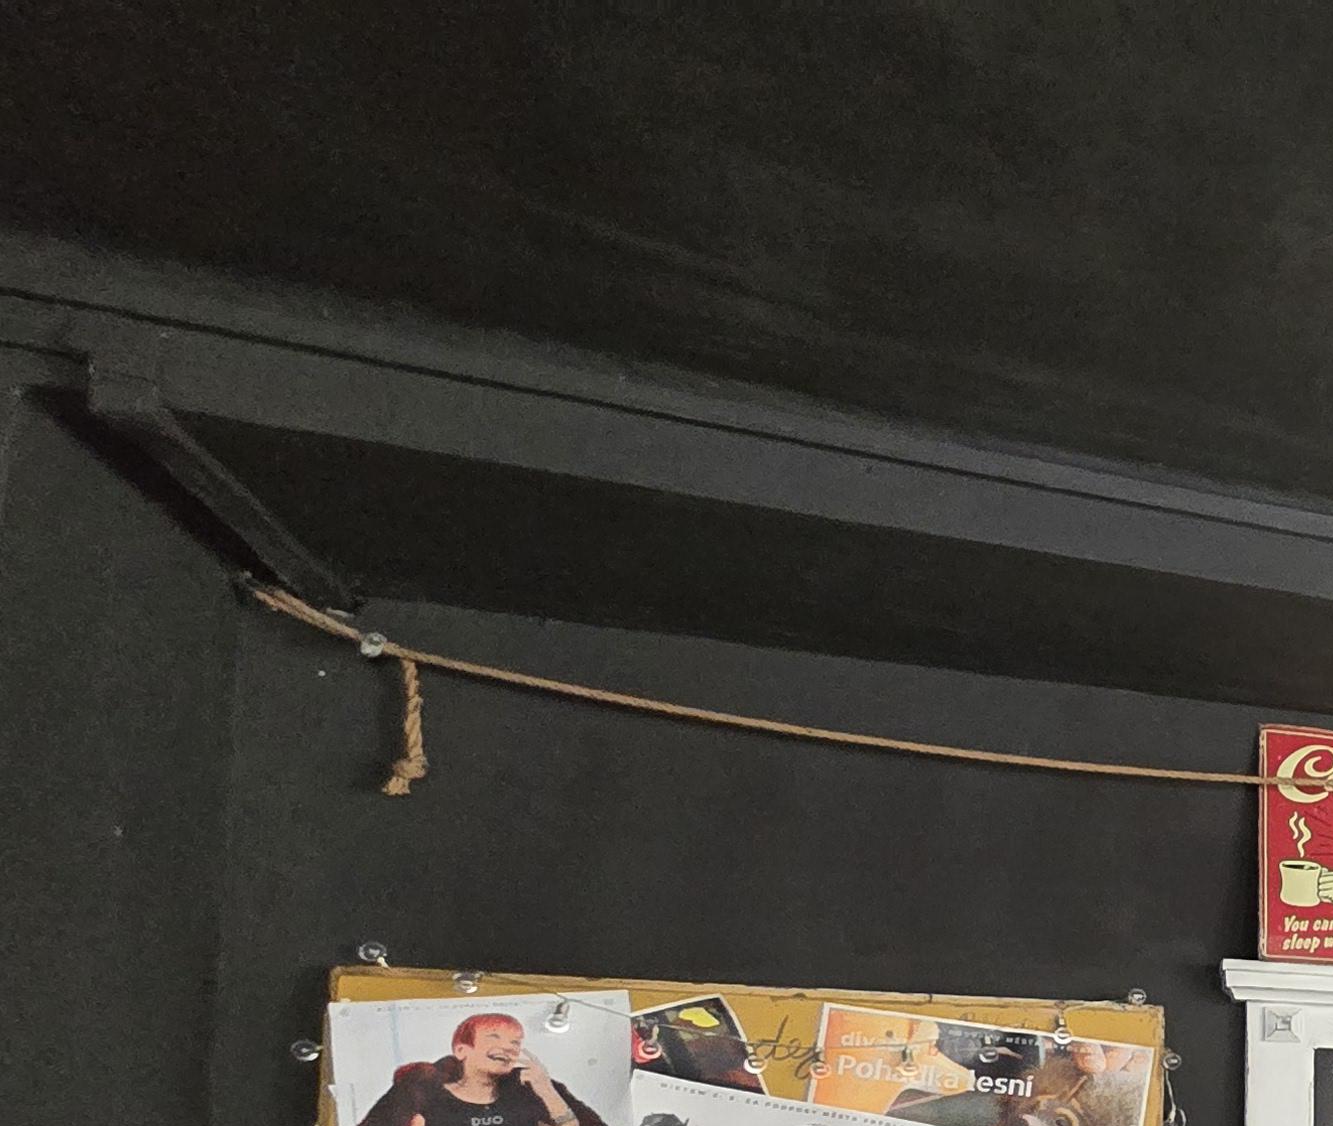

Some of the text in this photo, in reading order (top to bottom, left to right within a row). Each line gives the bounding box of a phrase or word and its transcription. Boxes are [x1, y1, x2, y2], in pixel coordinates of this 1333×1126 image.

[1283, 915, 1308, 932] You
[1283, 933, 1320, 953] sleep
[471, 1115, 504, 1126] DUO
